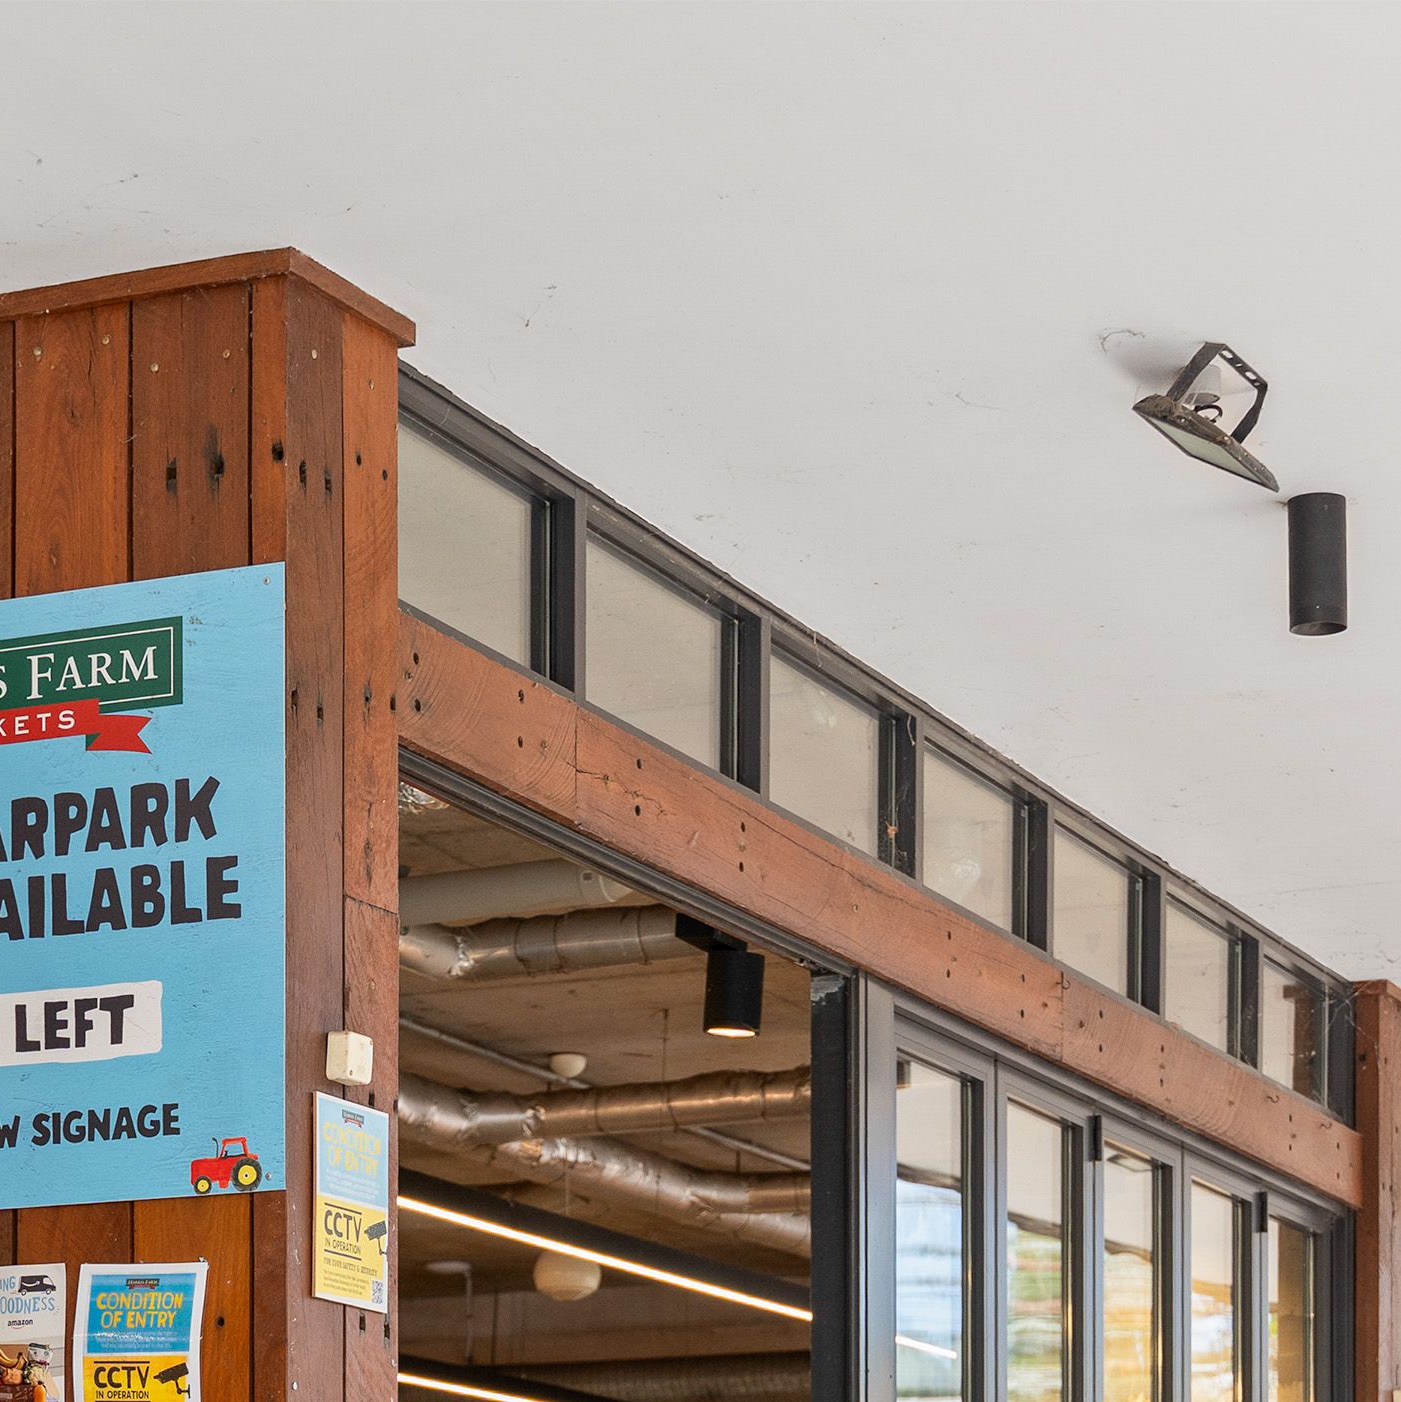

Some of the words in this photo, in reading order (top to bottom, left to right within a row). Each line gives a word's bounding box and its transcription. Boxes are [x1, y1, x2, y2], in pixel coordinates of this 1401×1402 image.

[28, 646, 158, 690] FARM
[17, 994, 134, 1052] LEFT
[33, 1103, 181, 1145] SIGNAGE
[324, 1209, 362, 1243] CCTV
[325, 1238, 330, 1248] IN
[332, 1240, 361, 1254] OPERATION
[97, 1292, 183, 1310] CONDITION
[8, 1319, 33, 1327] amazon
[101, 1312, 122, 1328] OF
[127, 1311, 177, 1328] ENTRY
[94, 1366, 150, 1389] CCTV
[96, 1391, 104, 1399] IN
[107, 1390, 149, 1400] OPERATION
